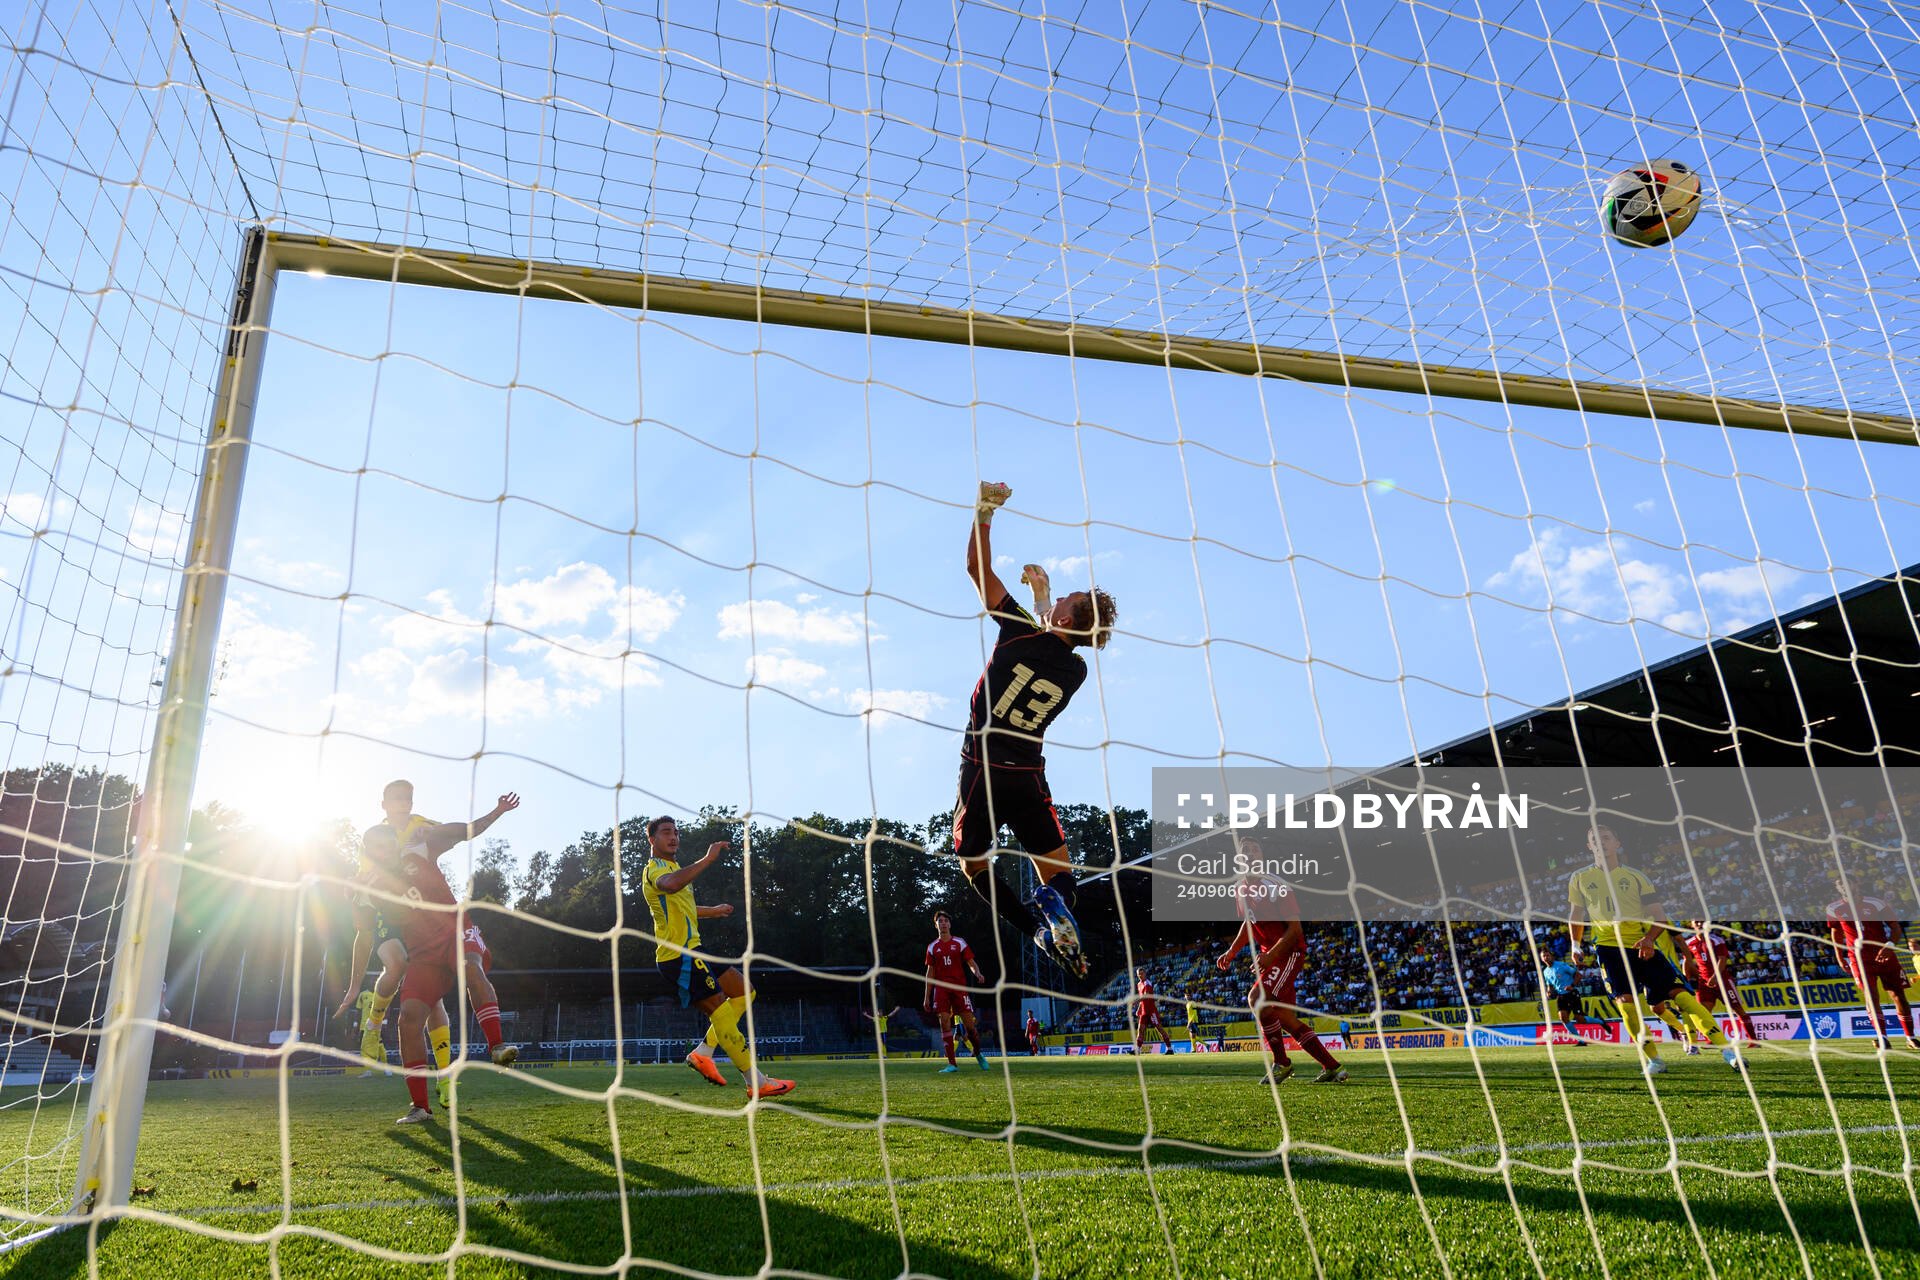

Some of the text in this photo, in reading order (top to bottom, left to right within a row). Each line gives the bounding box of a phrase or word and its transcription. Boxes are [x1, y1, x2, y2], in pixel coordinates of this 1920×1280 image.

[992, 663, 1063, 731] 13
[943, 955, 952, 966] 16
[1701, 952, 1708, 962] 8
[694, 958, 709, 973] 9
[1268, 966, 1281, 981] 3
[963, 995, 971, 1005] 16
[1728, 990, 1736, 999] 8
[1742, 982, 1861, 1009] VI ÄR SVERIGE
[1369, 1013, 1402, 1029] SRIGE!
[1751, 1021, 1790, 1032] ENSKA
[1363, 1033, 1446, 1050] SVEIGE-GIBRALTAR
[1475, 1031, 1525, 1047] Folksam
[1543, 1026, 1614, 1042] AUAUS
